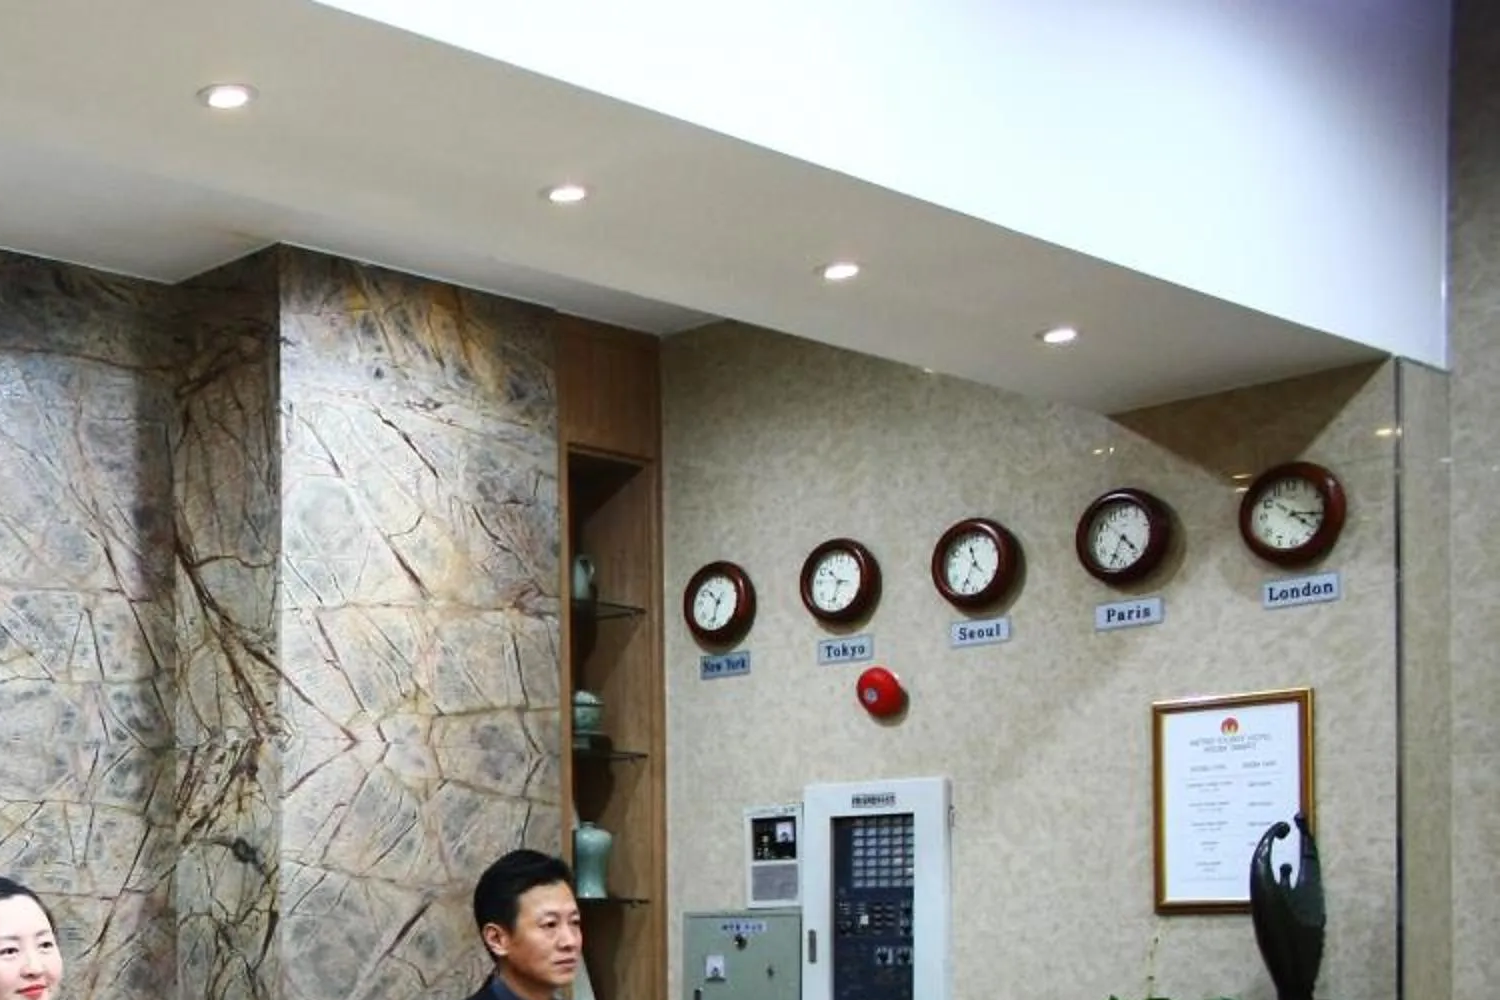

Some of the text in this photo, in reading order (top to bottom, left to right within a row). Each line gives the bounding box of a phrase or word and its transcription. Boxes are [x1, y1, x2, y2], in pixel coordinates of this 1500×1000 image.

[1267, 581, 1334, 601] London
[1106, 604, 1152, 623] Paris
[958, 623, 1001, 641] Seoul
[825, 642, 866, 658] Tokyo
[703, 657, 746, 673] New York
